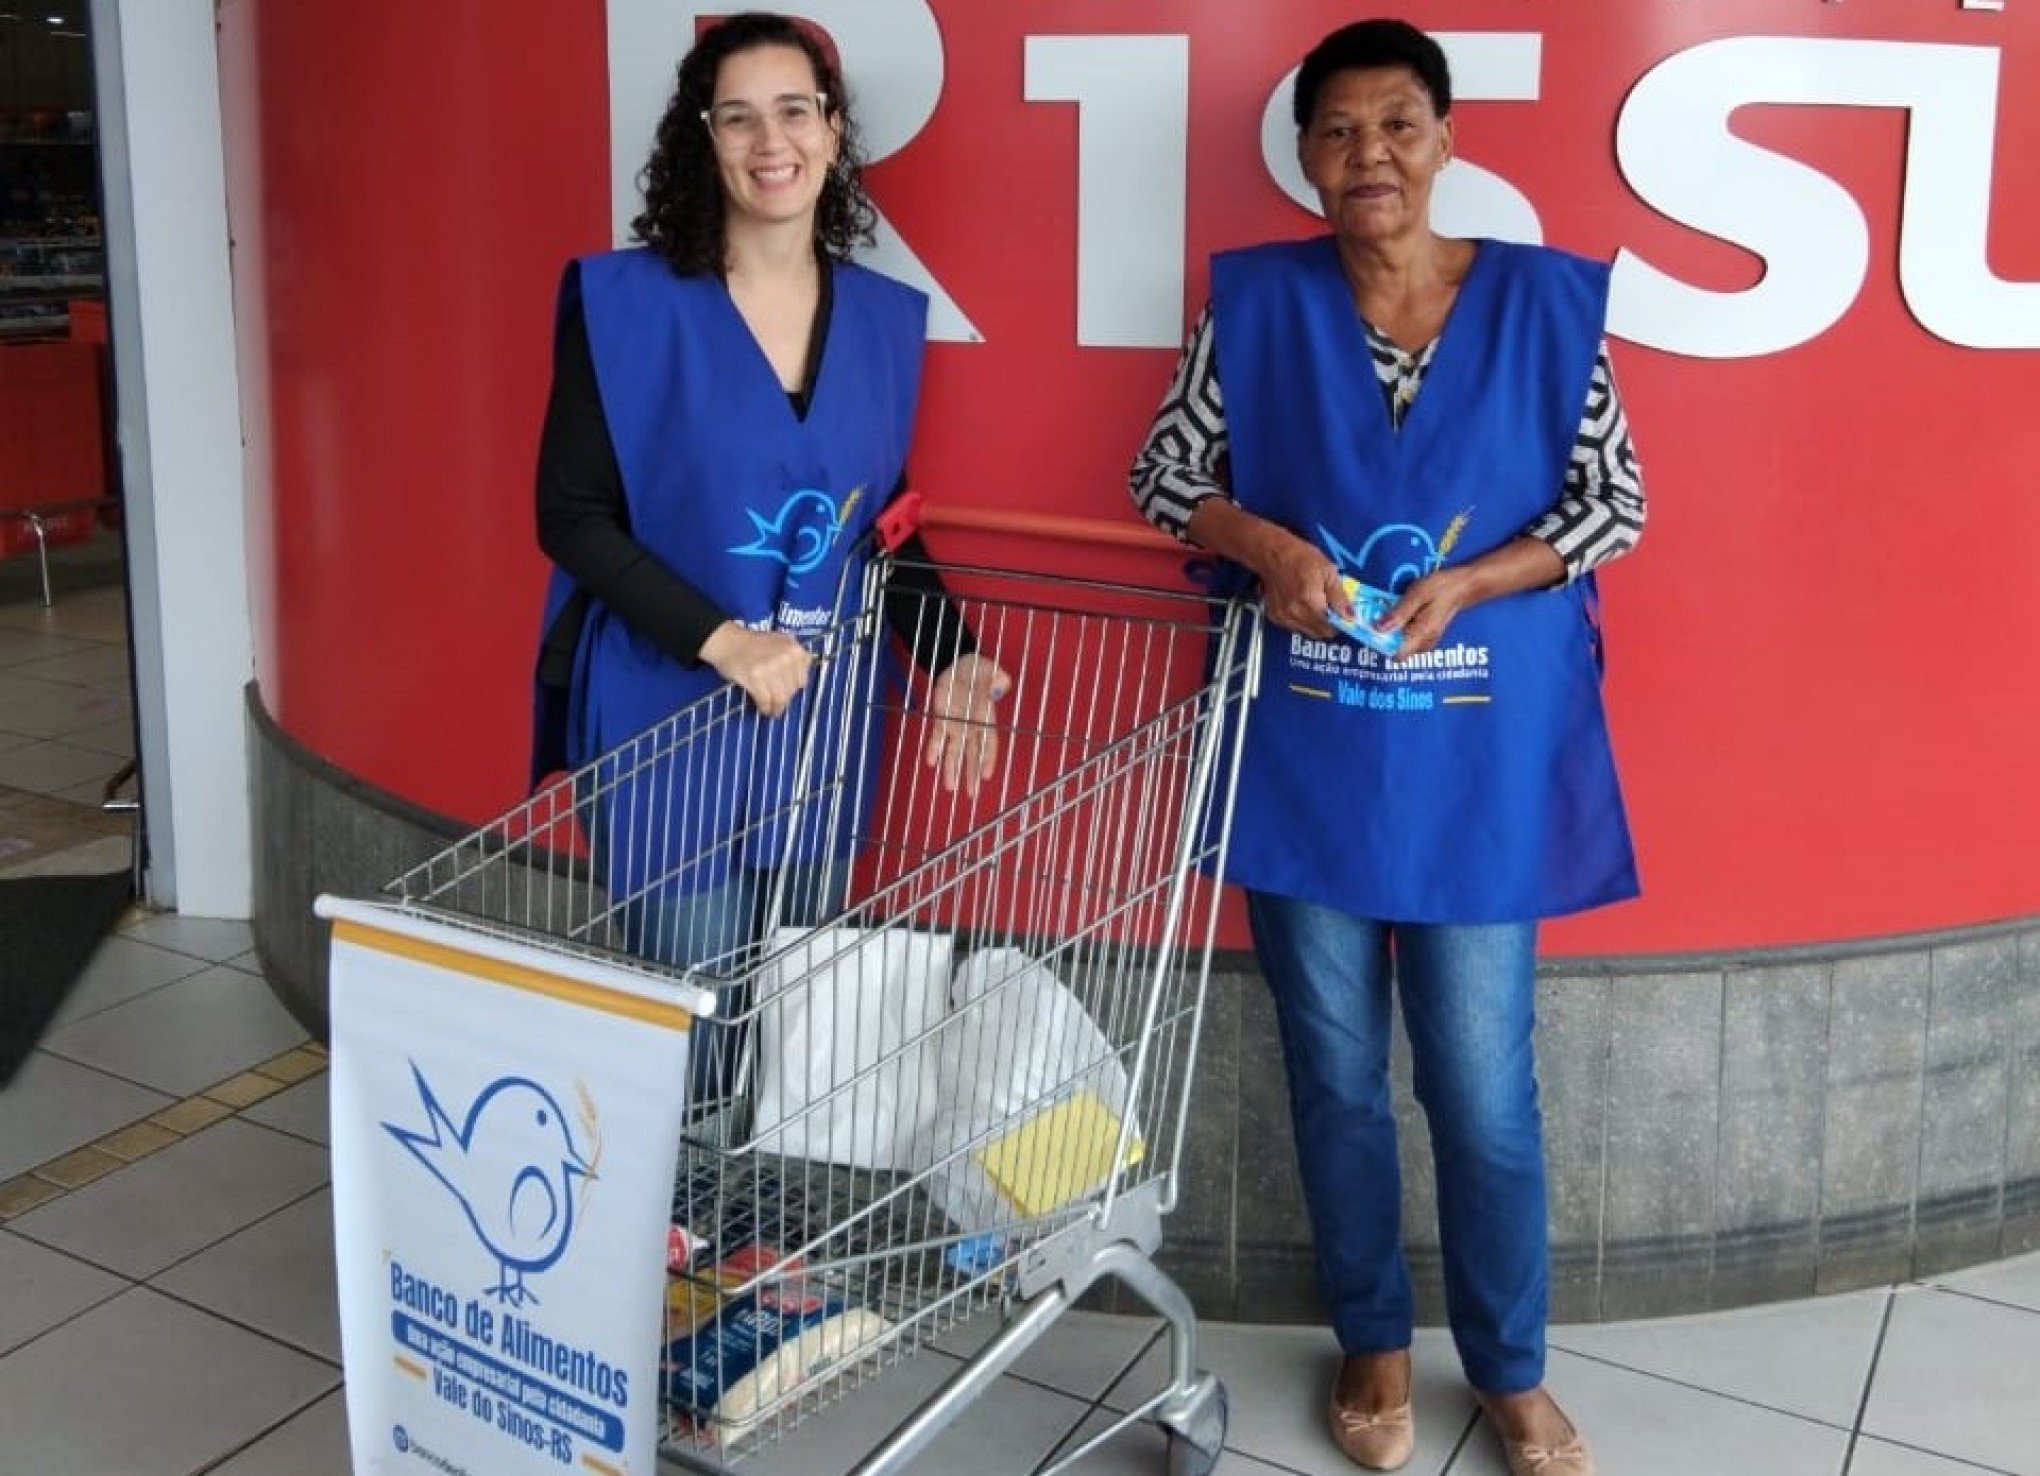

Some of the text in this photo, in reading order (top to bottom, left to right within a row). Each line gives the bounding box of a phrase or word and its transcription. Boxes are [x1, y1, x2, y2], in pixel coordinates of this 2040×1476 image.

[1291, 633, 1351, 664] Banco
[1357, 646, 1379, 668] de
[1338, 681, 1434, 710] Vale dos Sinos
[390, 1261, 629, 1408] Banco de Alimentos
[433, 1366, 467, 1410] Vale
[471, 1390, 493, 1424] do
